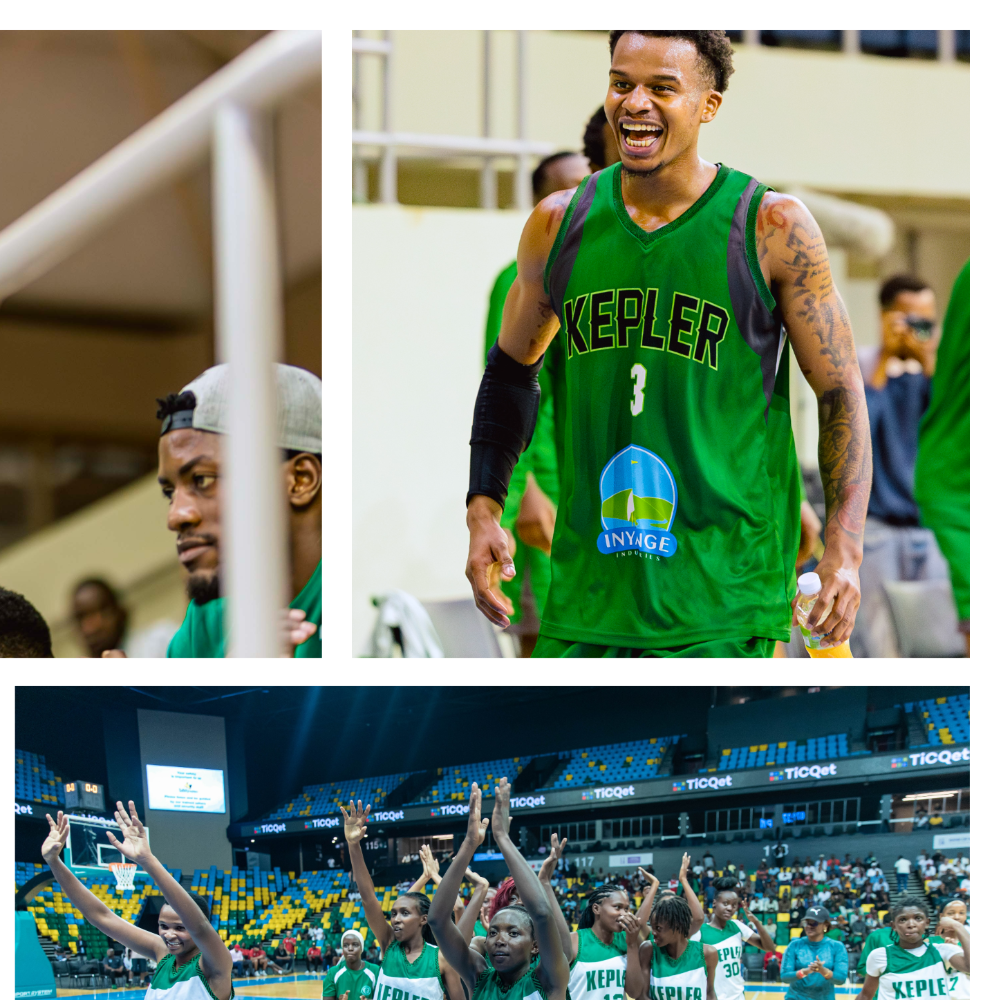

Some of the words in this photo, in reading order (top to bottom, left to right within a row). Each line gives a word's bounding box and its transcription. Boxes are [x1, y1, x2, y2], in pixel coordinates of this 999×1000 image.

[564, 288, 730, 371] KEPLER
[630, 363, 647, 417] 3
[909, 748, 970, 767] TiCQet
[784, 763, 837, 780] TiCQet
[686, 775, 733, 790] TiCQet
[594, 785, 635, 800] TiCQet
[510, 795, 545, 808] TiCQet
[374, 810, 404, 823] TiCQet
[440, 804, 470, 816] TiCQe
[261, 823, 286, 834] TiCQet
[312, 818, 339, 830] TiCQet
[575, 856, 595, 868] 117
[723, 962, 740, 978] 30
